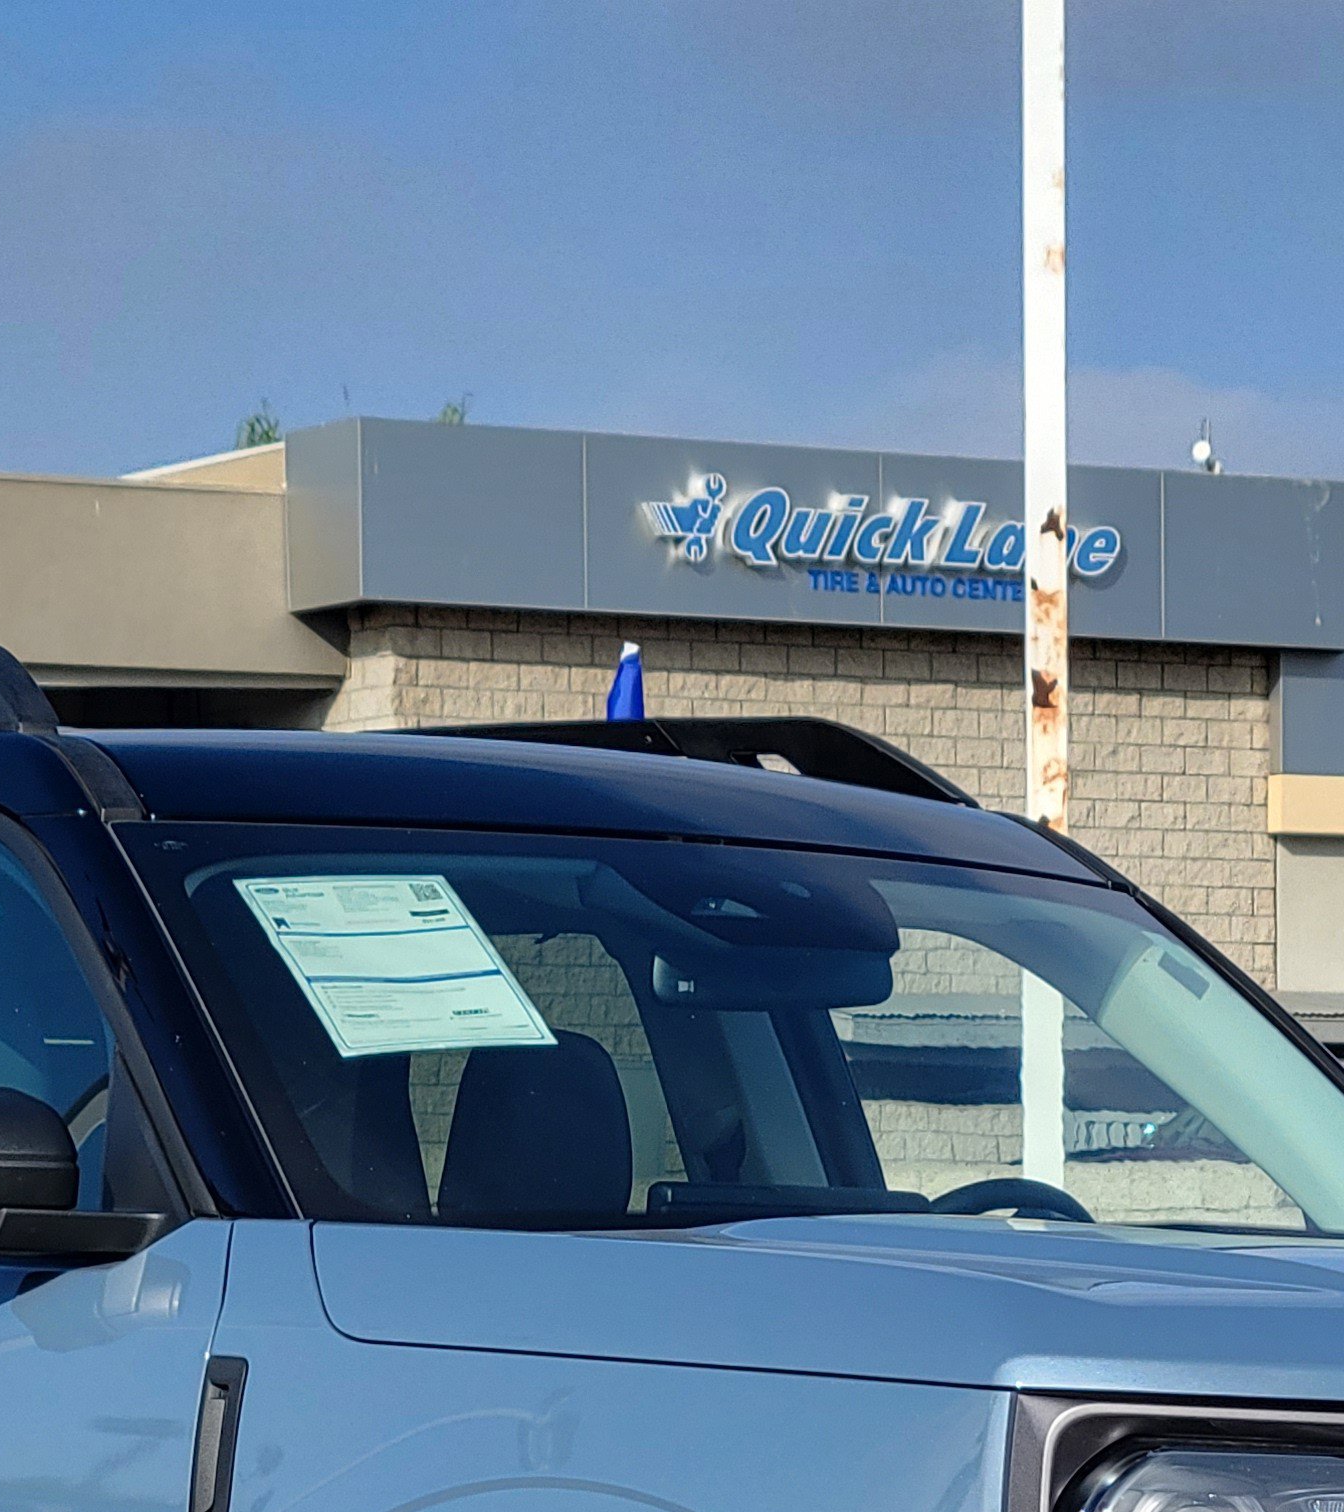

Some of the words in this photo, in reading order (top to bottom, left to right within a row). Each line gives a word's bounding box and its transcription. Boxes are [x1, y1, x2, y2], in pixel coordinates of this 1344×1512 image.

[732, 487, 942, 566] Quick
[942, 501, 1120, 576] Lae
[808, 570, 858, 593] TIRE
[866, 572, 880, 593] &
[887, 574, 946, 597] AUTO
[952, 576, 1025, 602] CENTE
